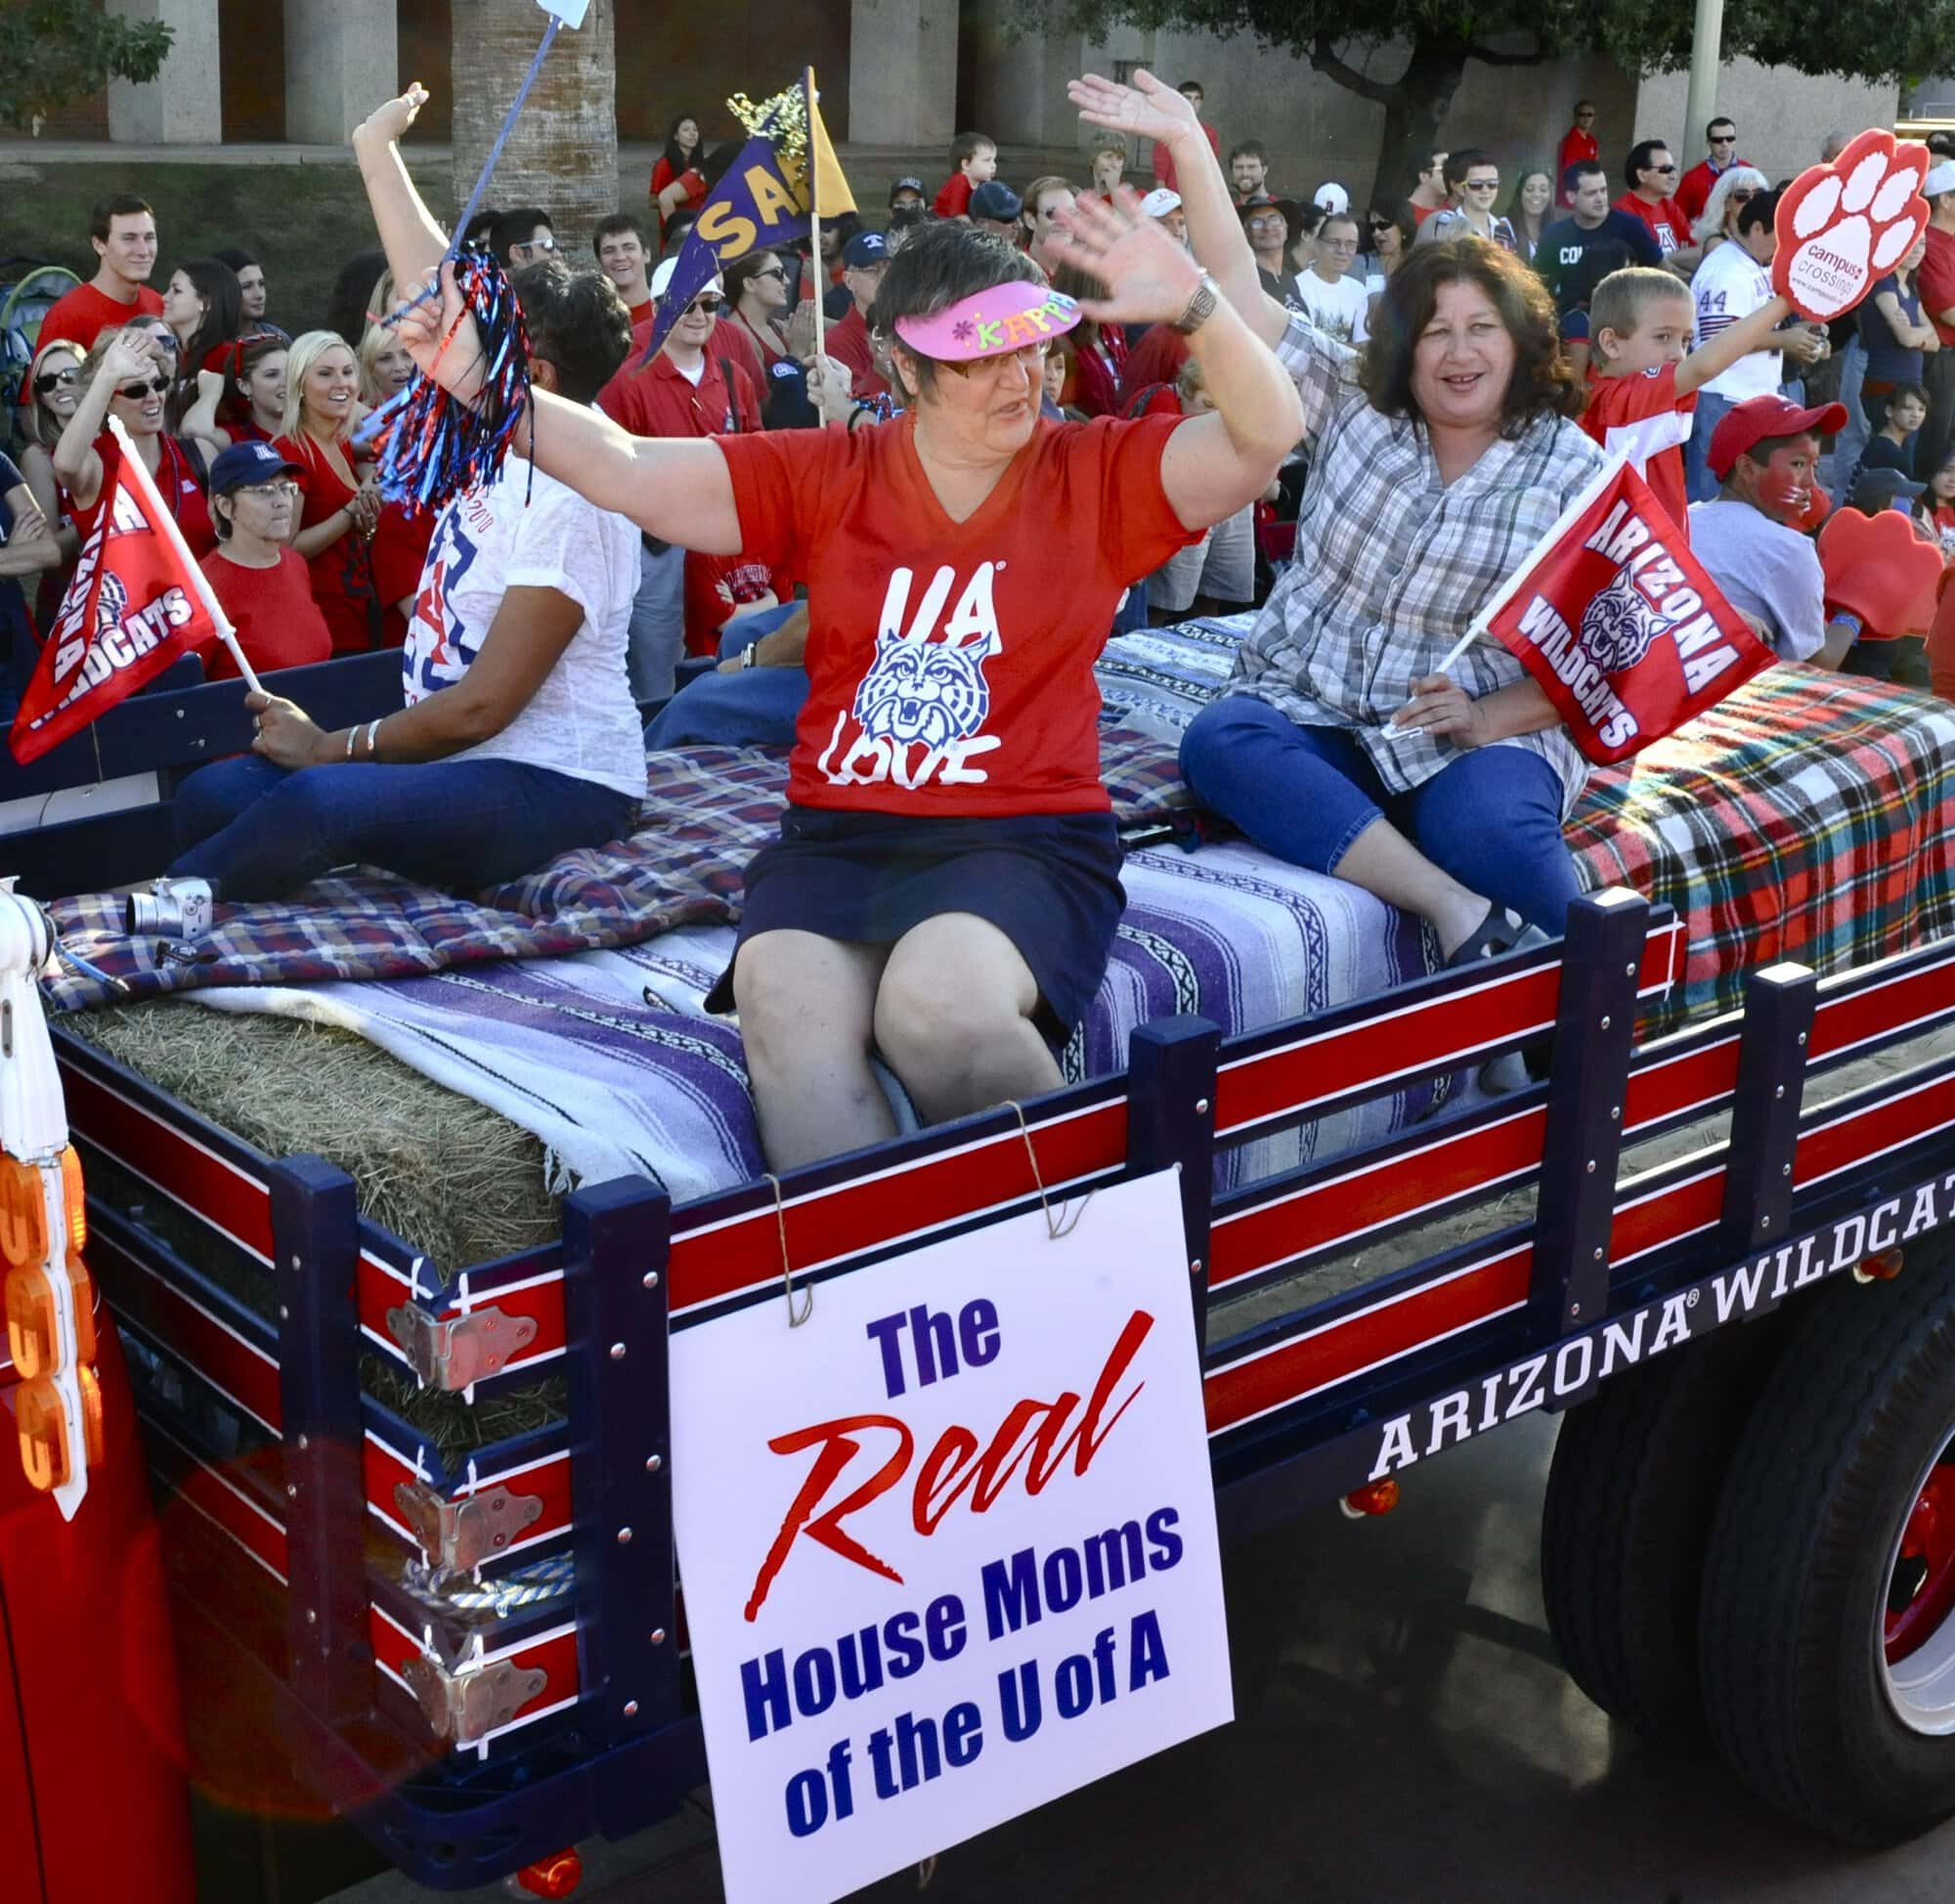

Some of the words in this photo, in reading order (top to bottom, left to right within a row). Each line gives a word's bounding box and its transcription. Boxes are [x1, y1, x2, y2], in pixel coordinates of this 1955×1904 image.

[1699, 289, 1727, 312] 44
[1798, 260, 1854, 295] crossings
[1807, 243, 1856, 276] campus
[1585, 498, 1740, 696] ARIZONA
[1517, 594, 1638, 748] WILDCATS
[817, 710, 1002, 790] LOVE
[866, 1298, 1001, 1400] The
[744, 1309, 1154, 1623] Real
[740, 1593, 968, 1743] House
[980, 1506, 1184, 1641] Moms
[785, 1738, 854, 1838] of
[868, 1700, 983, 1802] the
[998, 1659, 1041, 1743] U
[1055, 1634, 1117, 1721] of
[1128, 1609, 1172, 1692] A
